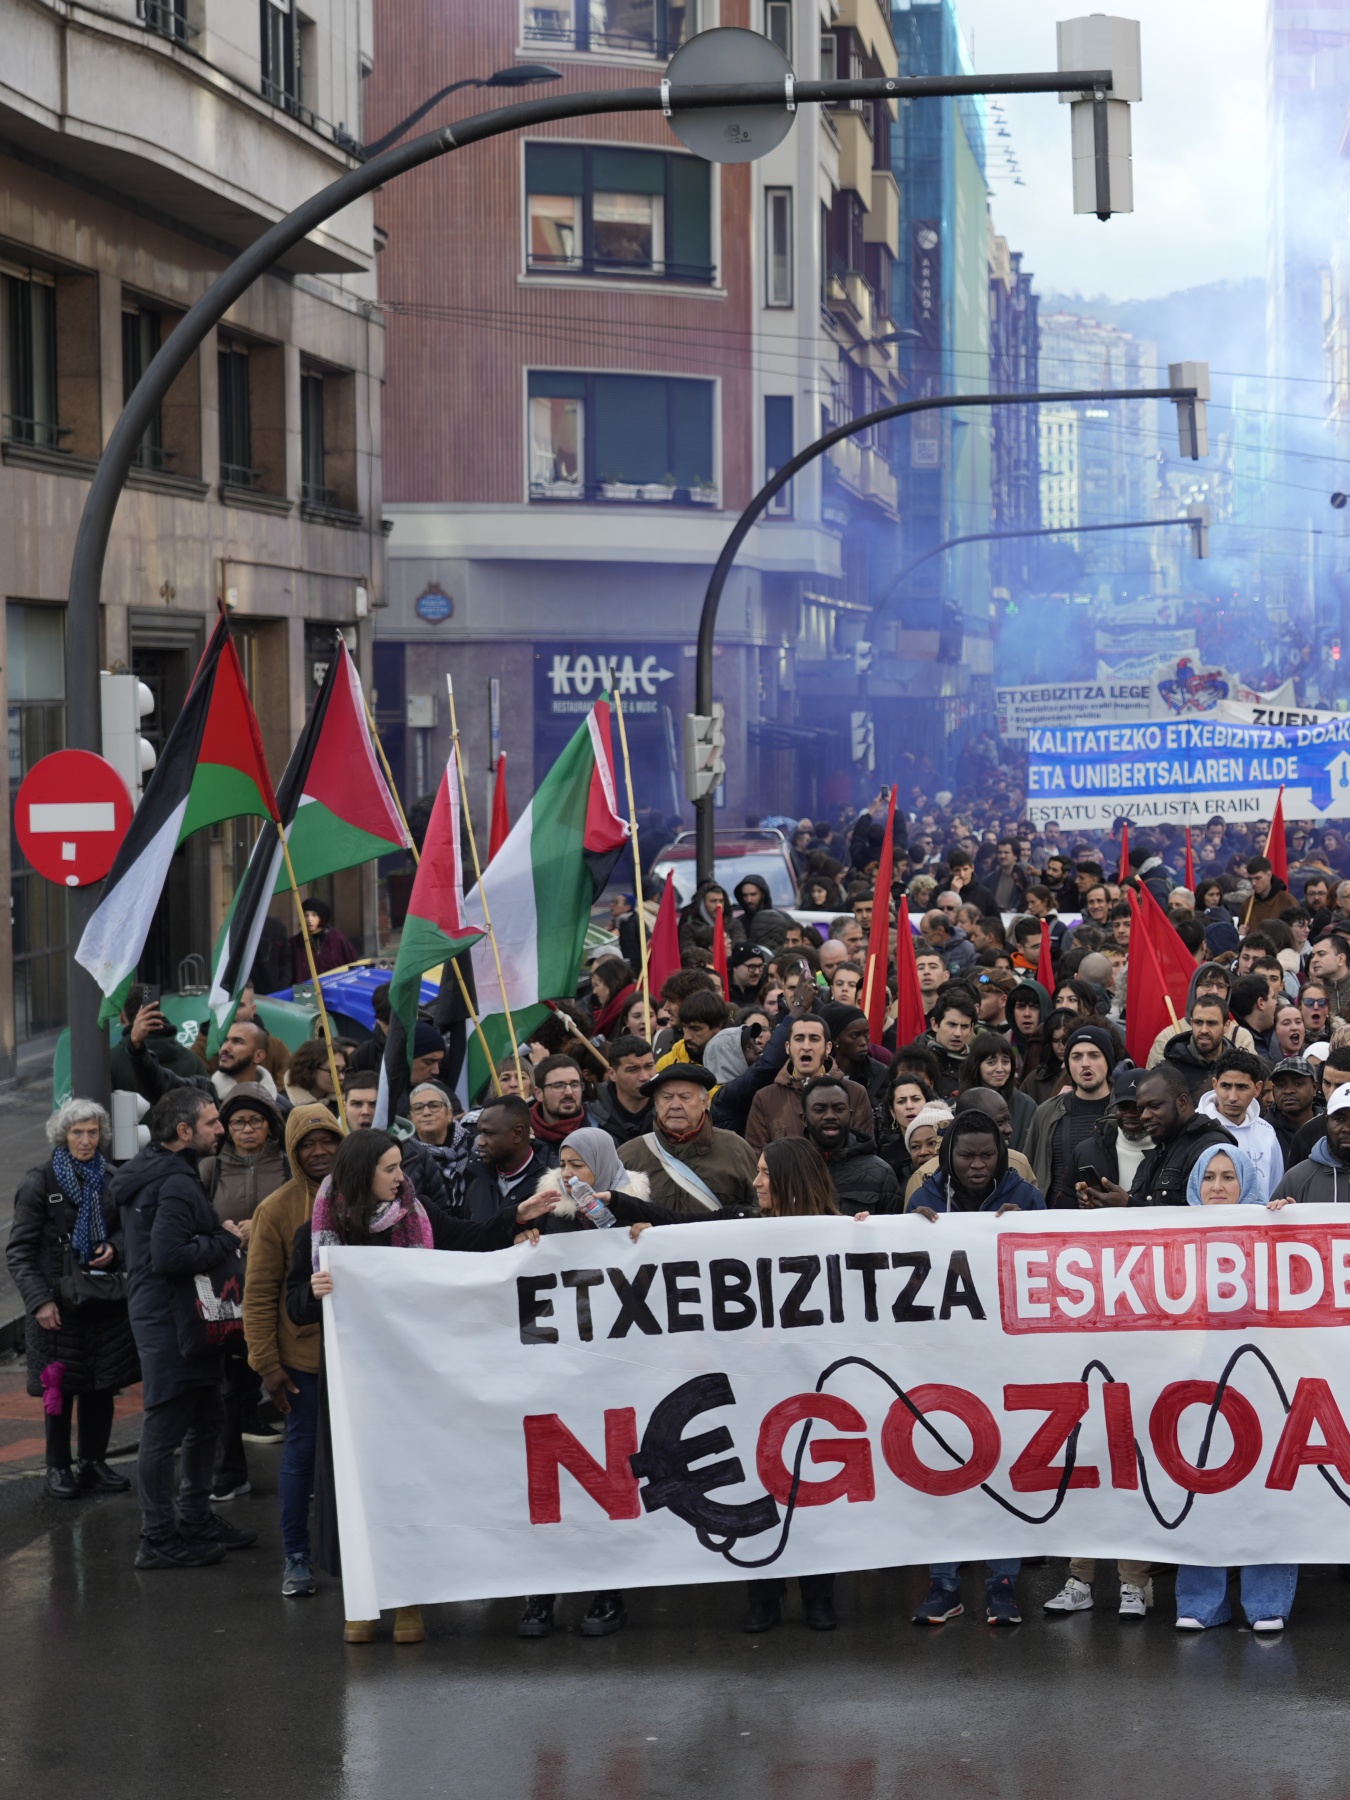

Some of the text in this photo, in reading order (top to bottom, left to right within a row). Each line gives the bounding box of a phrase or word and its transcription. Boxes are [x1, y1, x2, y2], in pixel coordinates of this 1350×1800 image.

[553, 655, 657, 695] KOVAC
[637, 701, 658, 713] MUSIC
[998, 686, 1105, 704] ETXEBIZITZA
[1252, 708, 1318, 727] ZUEN
[1029, 726, 1162, 753] KALITATEZKO
[1167, 724, 1292, 750] ETXEBIZITZA,
[1029, 756, 1299, 790] ETA UNIBERTSALAREN ALDE
[1029, 797, 1260, 823] ESTATU SOZIALISTA ERAIKI
[517, 1249, 987, 1345] ETXEBIZITZA
